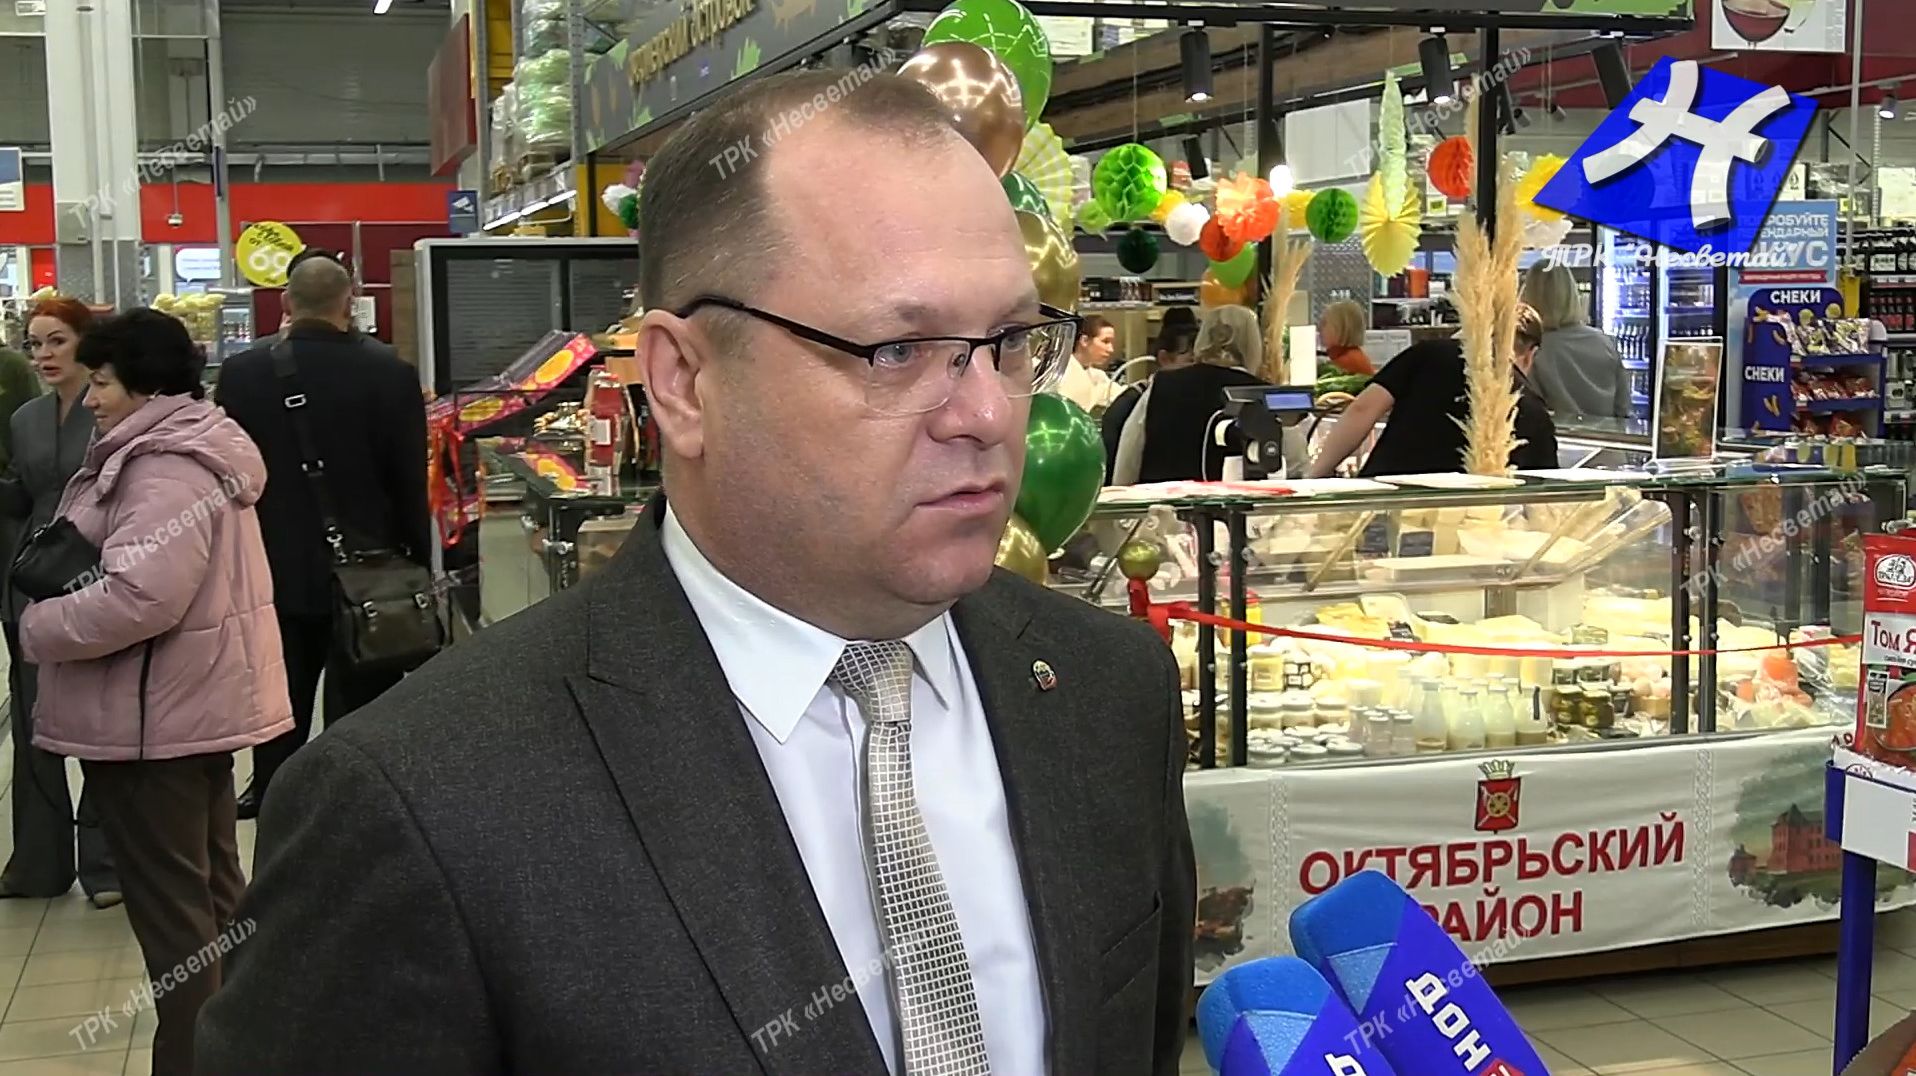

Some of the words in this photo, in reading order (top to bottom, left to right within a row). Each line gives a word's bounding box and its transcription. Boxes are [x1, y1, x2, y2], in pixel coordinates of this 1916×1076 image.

[1769, 290, 1821, 304] СНЕКИ
[1744, 365, 1785, 383] СНЕКИ
[1299, 811, 1685, 896] ОКТЯБРЬСКИЙ
